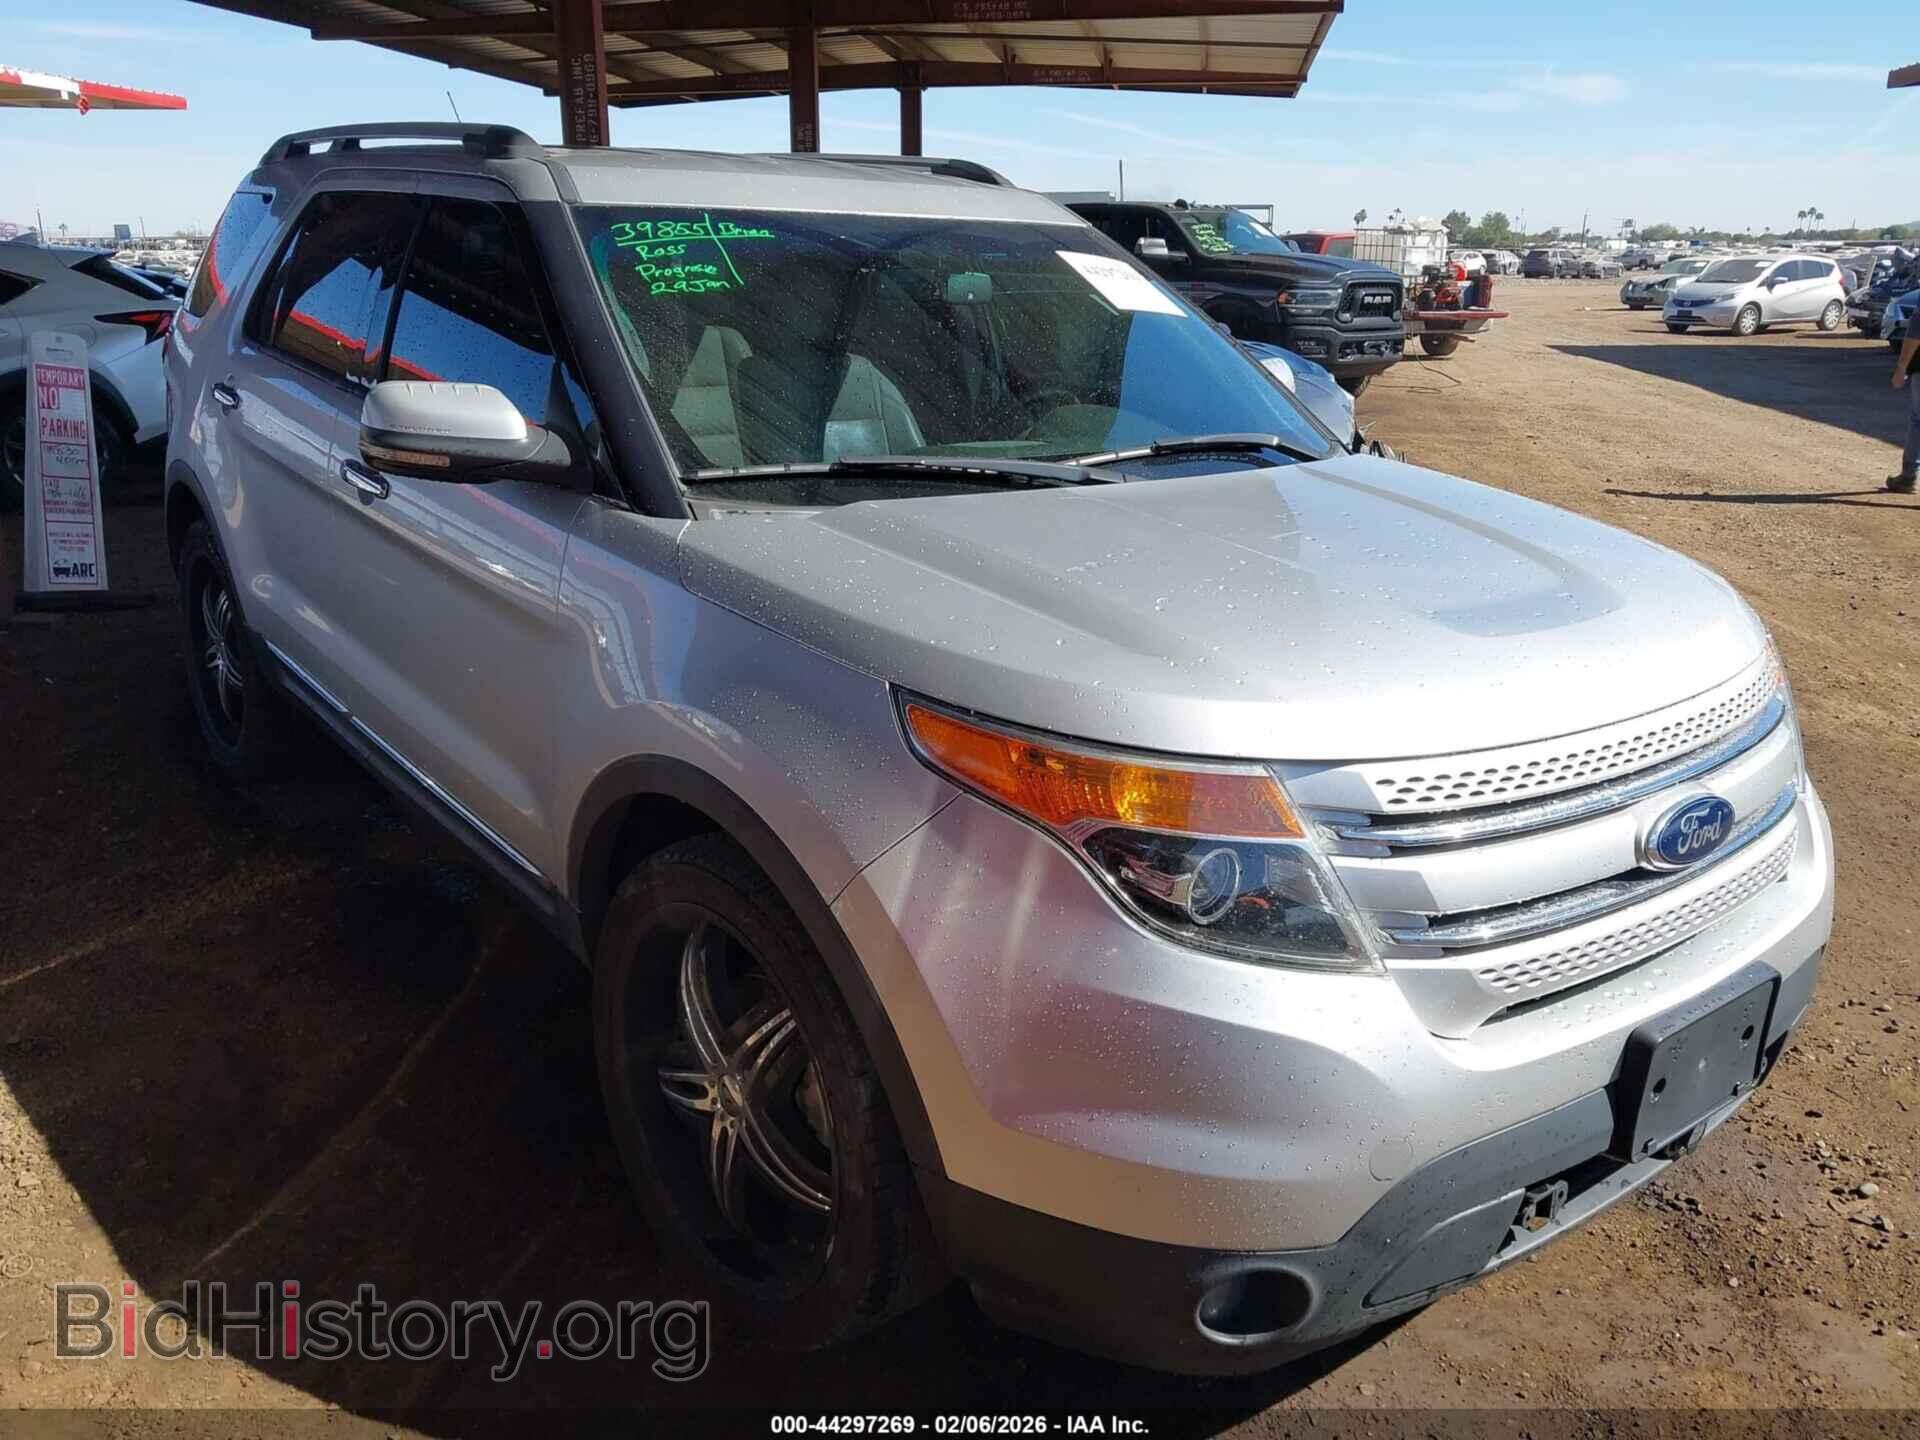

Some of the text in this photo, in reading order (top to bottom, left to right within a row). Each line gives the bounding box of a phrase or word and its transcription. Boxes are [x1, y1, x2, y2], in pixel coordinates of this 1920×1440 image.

[635, 244, 687, 260] Ross
[1364, 296, 1391, 304] RAM
[36, 367, 84, 385] TEMPORARY
[38, 385, 59, 409] NO
[40, 415, 87, 439] PARKING
[72, 562, 96, 578] ARC
[1678, 808, 1721, 854] Ford
